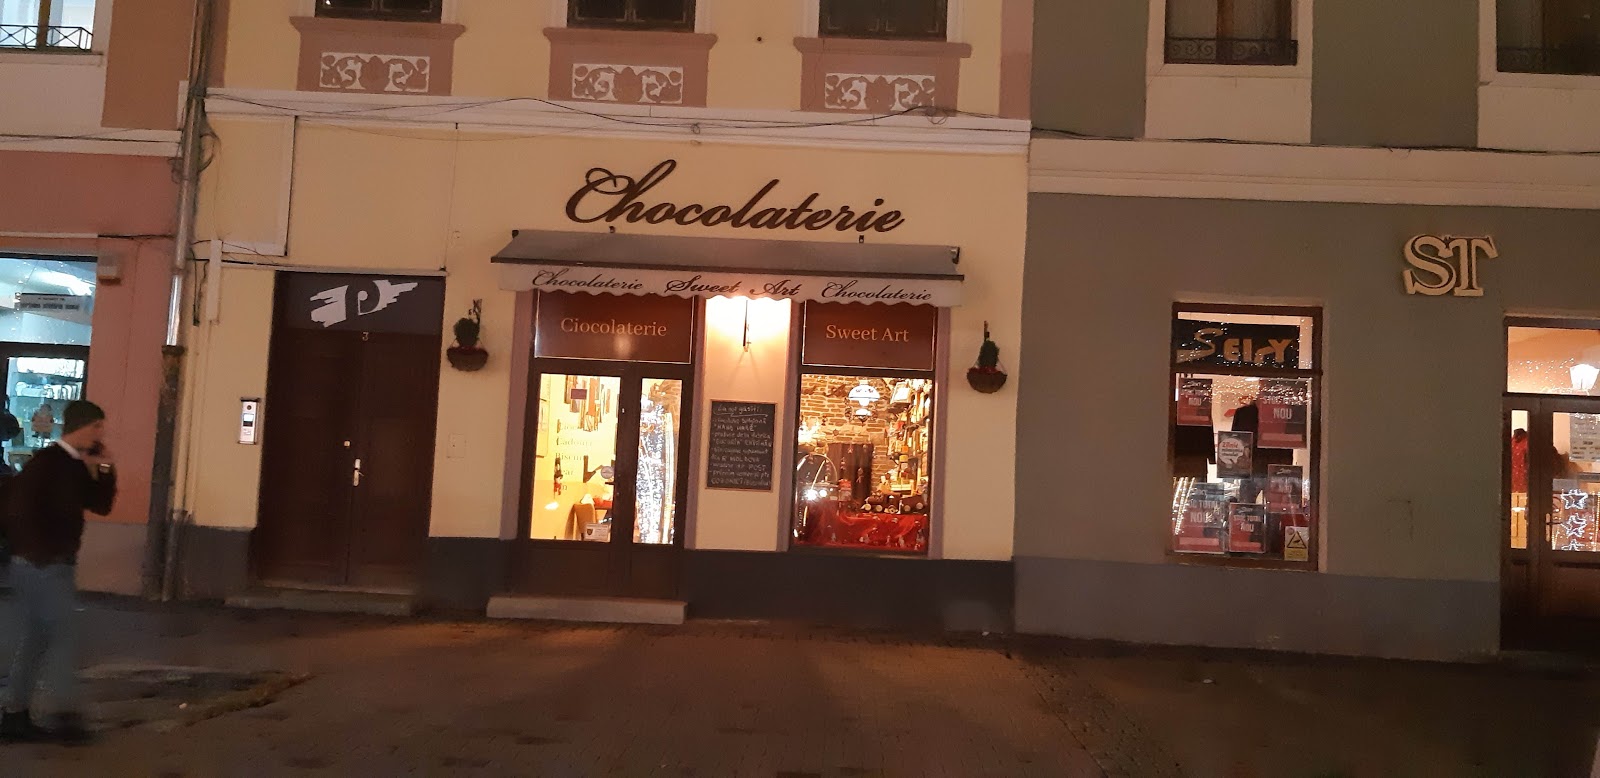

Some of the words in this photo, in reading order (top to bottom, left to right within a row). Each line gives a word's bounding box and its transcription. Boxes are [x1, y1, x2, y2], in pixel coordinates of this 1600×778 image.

[565, 159, 906, 233] Chocolaterie
[1402, 233, 1499, 297] ST
[532, 268, 643, 291] Chocolaterie
[665, 274, 740, 296] Sweet
[750, 279, 801, 297] Art
[821, 280, 932, 301] Chocolaterie
[362, 332, 369, 342] 3
[560, 317, 667, 337] Ciocolaterie
[825, 323, 877, 342] Sweet
[881, 326, 910, 343] Art
[1273, 408, 1293, 420] NOU
[1240, 522, 1255, 533] NOU
